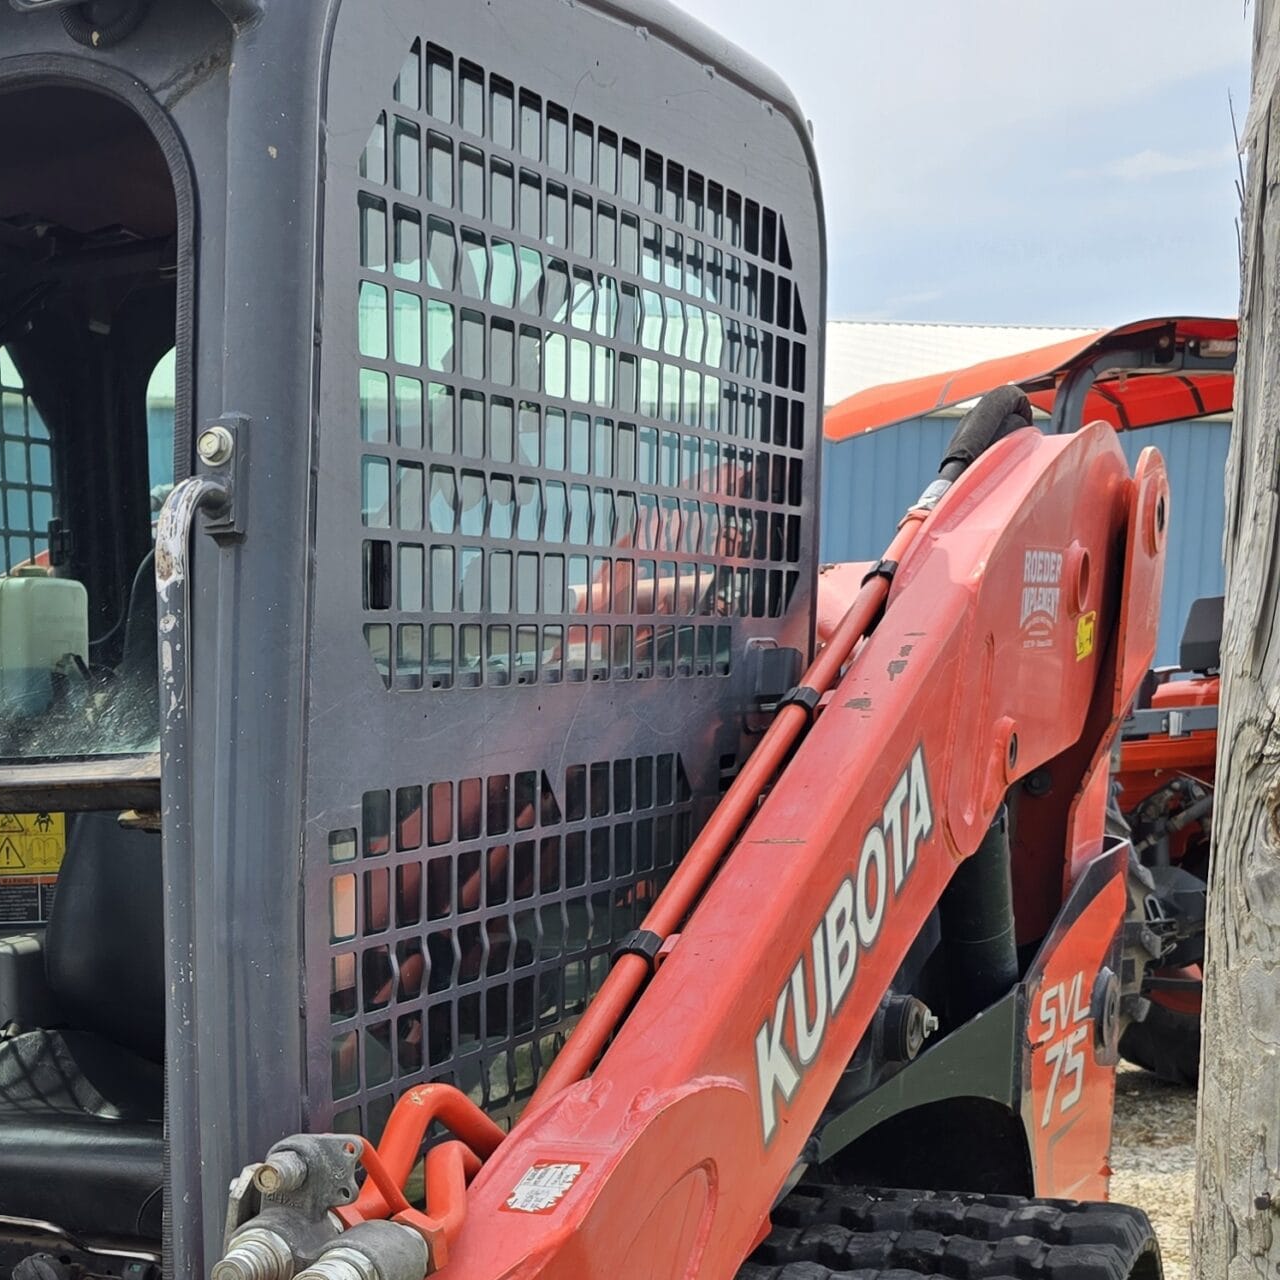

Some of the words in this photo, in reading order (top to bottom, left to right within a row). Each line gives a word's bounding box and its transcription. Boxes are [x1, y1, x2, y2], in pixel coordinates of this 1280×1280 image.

[1023, 549, 1062, 583] ROEDER
[756, 748, 933, 1144] KUBOTA
[1038, 970, 1091, 1043] SVL
[1040, 1024, 1088, 1128] 75
